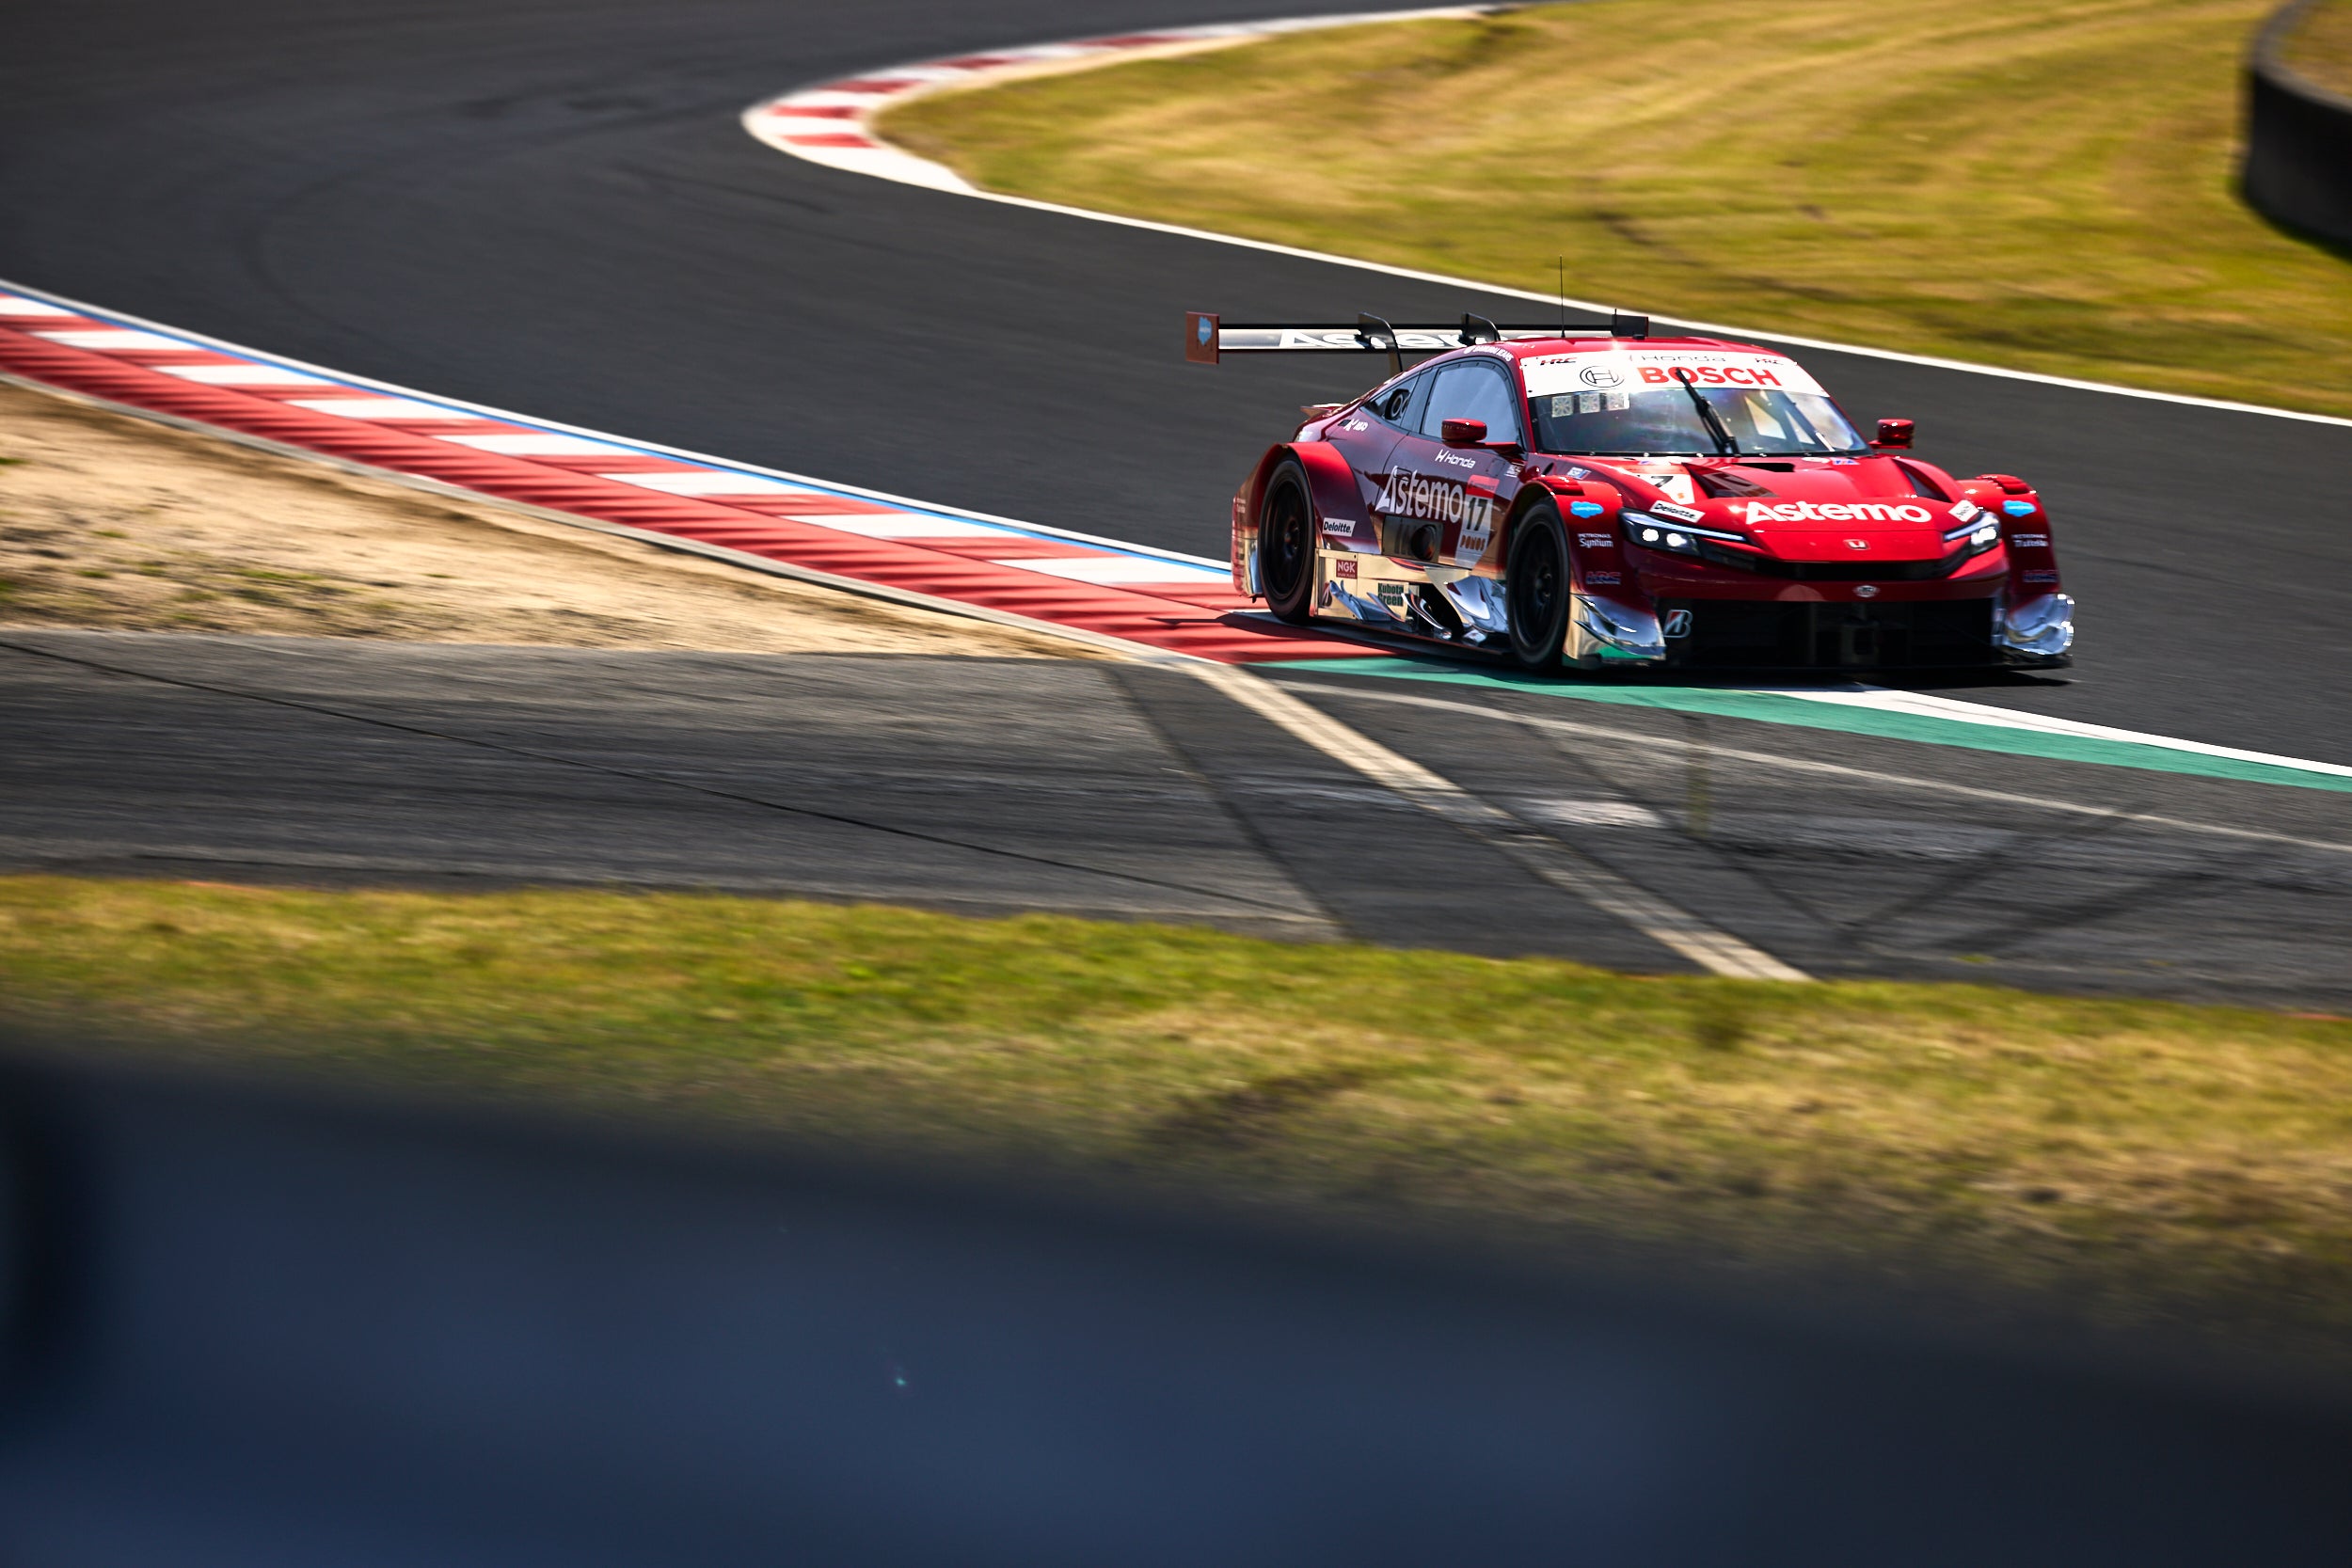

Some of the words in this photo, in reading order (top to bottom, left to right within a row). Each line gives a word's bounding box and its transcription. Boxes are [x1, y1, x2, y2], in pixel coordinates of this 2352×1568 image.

[1637, 367, 1782, 387] BOSCH
[1445, 453, 1476, 469] Honda
[1375, 466, 1463, 524] Astemo
[1466, 497, 1488, 531] 17
[1746, 500, 1931, 525] Astemo
[1337, 561, 1356, 574] NGK
[1377, 582, 1405, 595] Kubota
